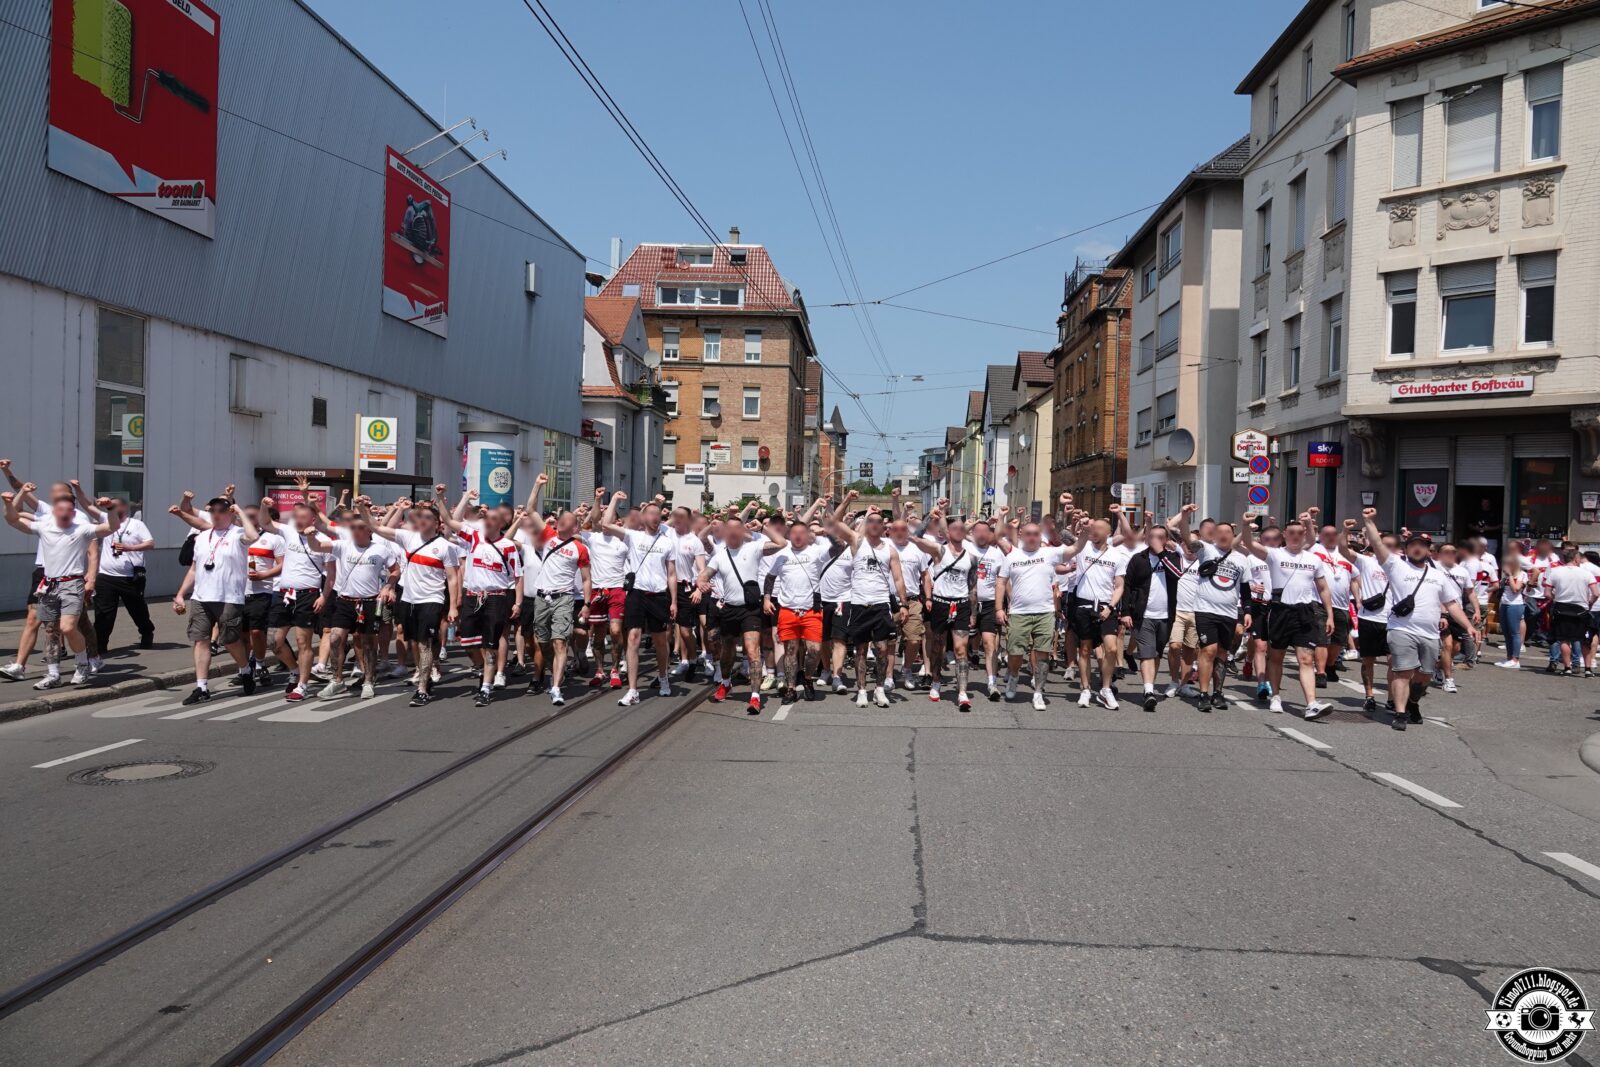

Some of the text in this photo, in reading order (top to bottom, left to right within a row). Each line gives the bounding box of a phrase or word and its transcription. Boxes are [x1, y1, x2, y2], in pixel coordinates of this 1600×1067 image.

[158, 182, 193, 198] toom
[1398, 377, 1525, 395] Stuttgarter Hofbräu
[374, 424, 384, 437] H
[1236, 444, 1266, 452] Hofräu
[1317, 444, 1333, 454] sky
